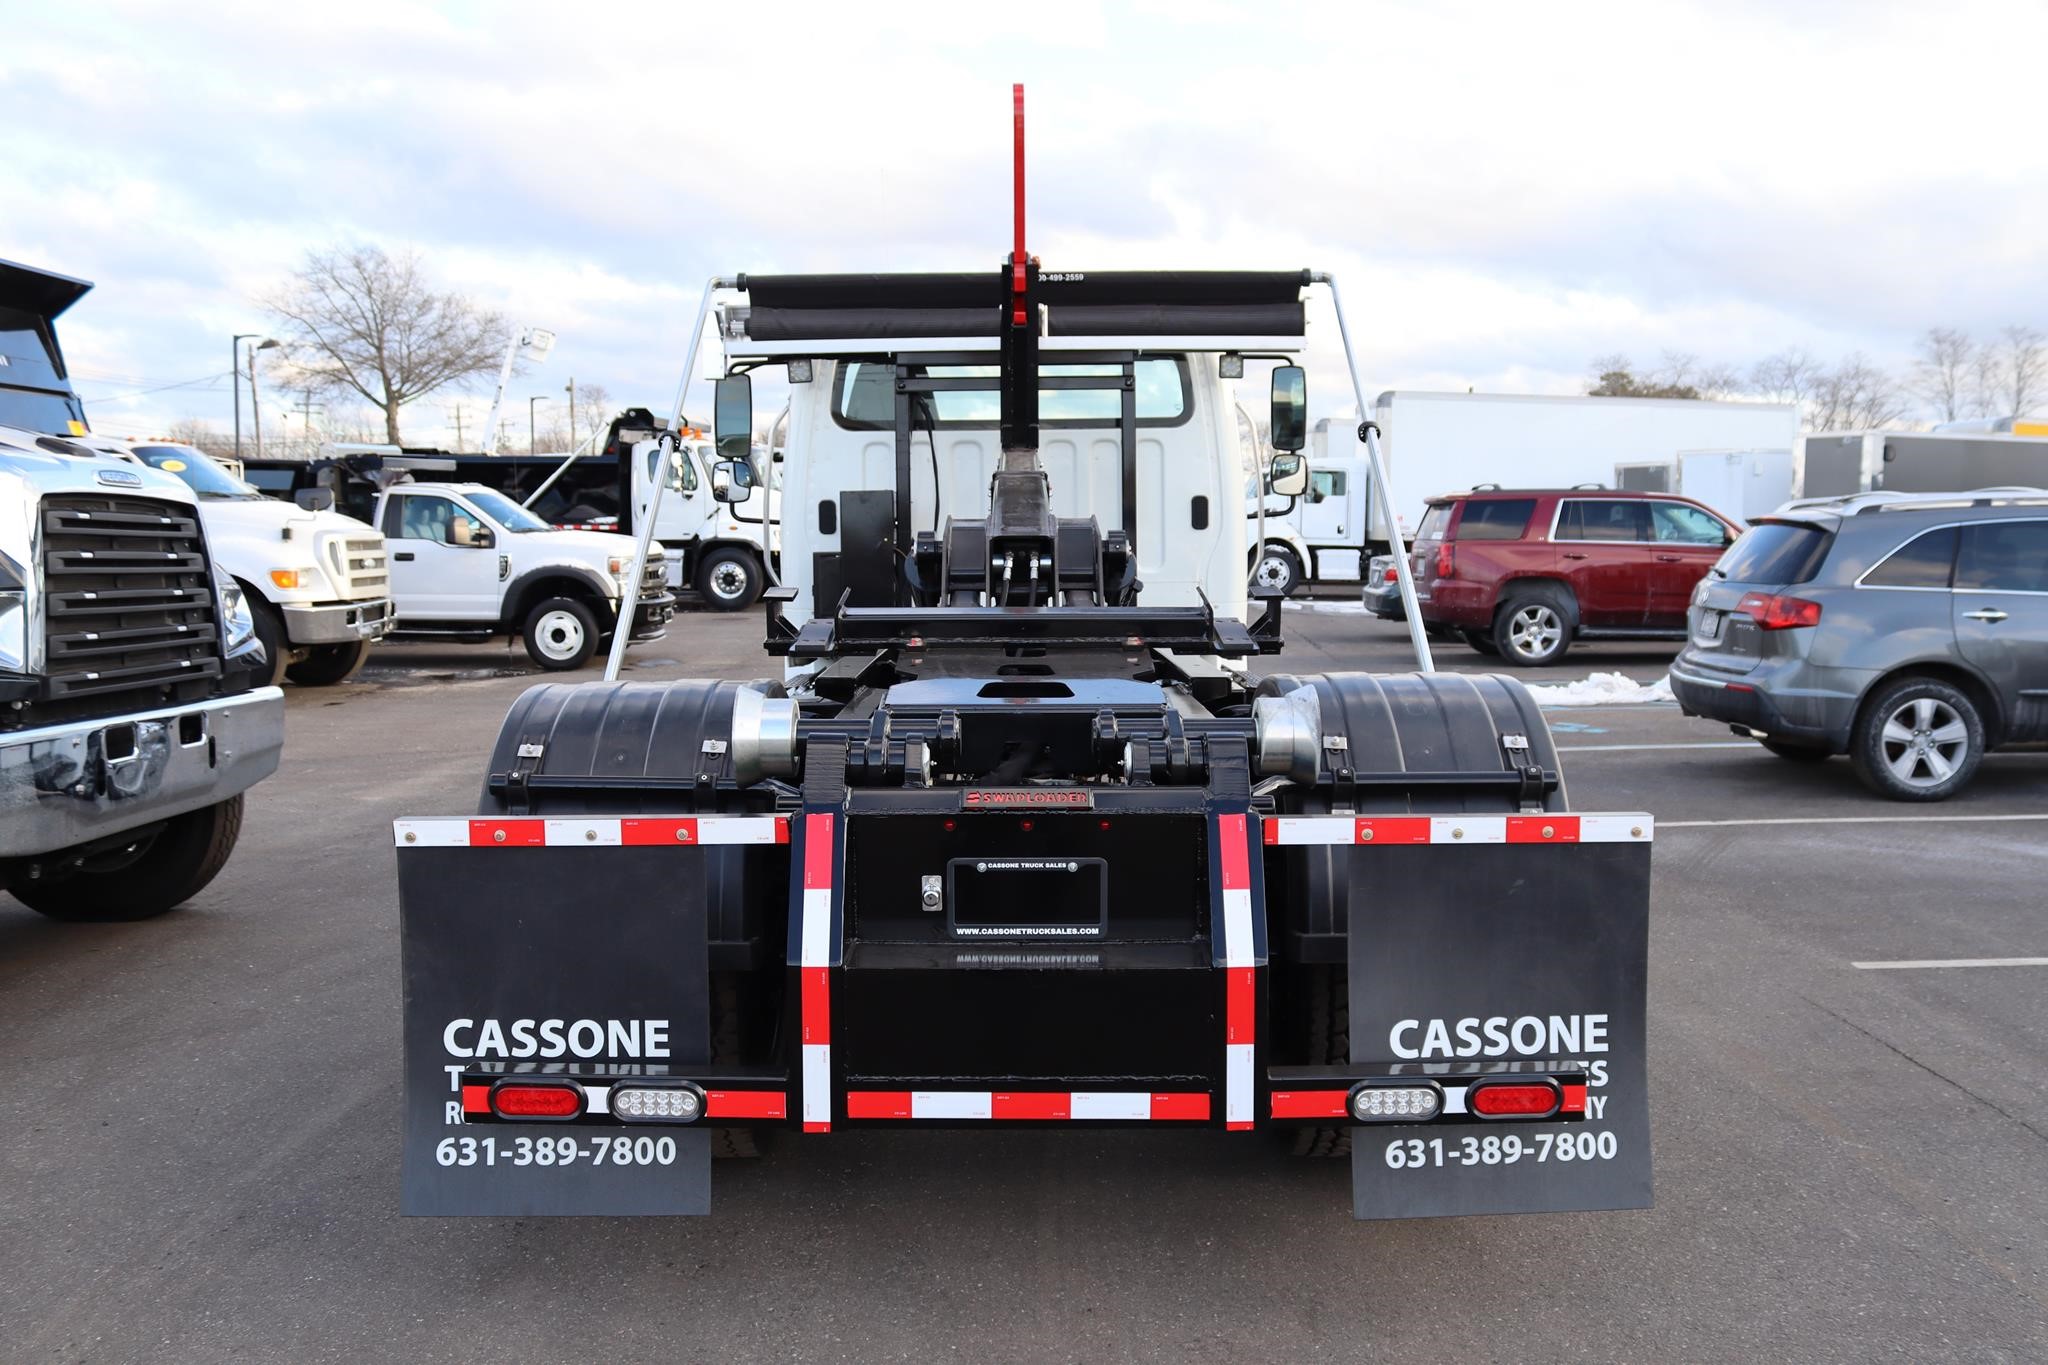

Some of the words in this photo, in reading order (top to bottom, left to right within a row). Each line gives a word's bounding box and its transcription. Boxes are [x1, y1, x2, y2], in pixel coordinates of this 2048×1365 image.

[983, 791, 1087, 803] SWAPLOADER
[443, 1018, 671, 1058] CASSONE
[1389, 1014, 1609, 1059] CASSONE
[435, 1136, 677, 1166] 631-389-7800
[1385, 1131, 1618, 1169] 631-389-7800
